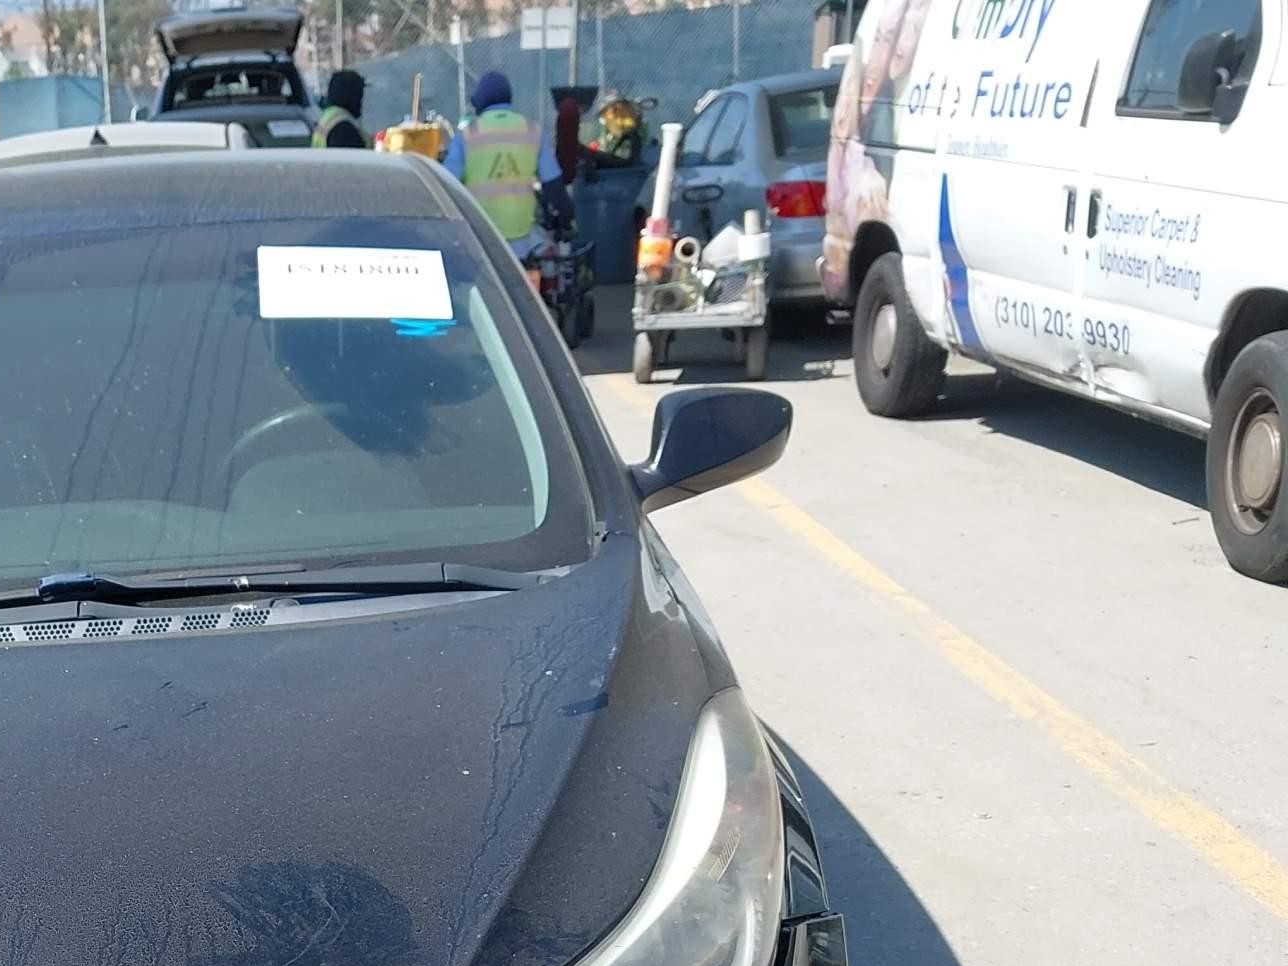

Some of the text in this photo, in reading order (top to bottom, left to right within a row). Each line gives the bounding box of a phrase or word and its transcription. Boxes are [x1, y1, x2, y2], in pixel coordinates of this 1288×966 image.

[970, 70, 1072, 119] Future
[1104, 203, 1149, 240] Superior
[1151, 208, 1189, 248] Carpet
[1099, 243, 1202, 301] Upholstery Cleaning
[994, 296, 1038, 337] (310)
